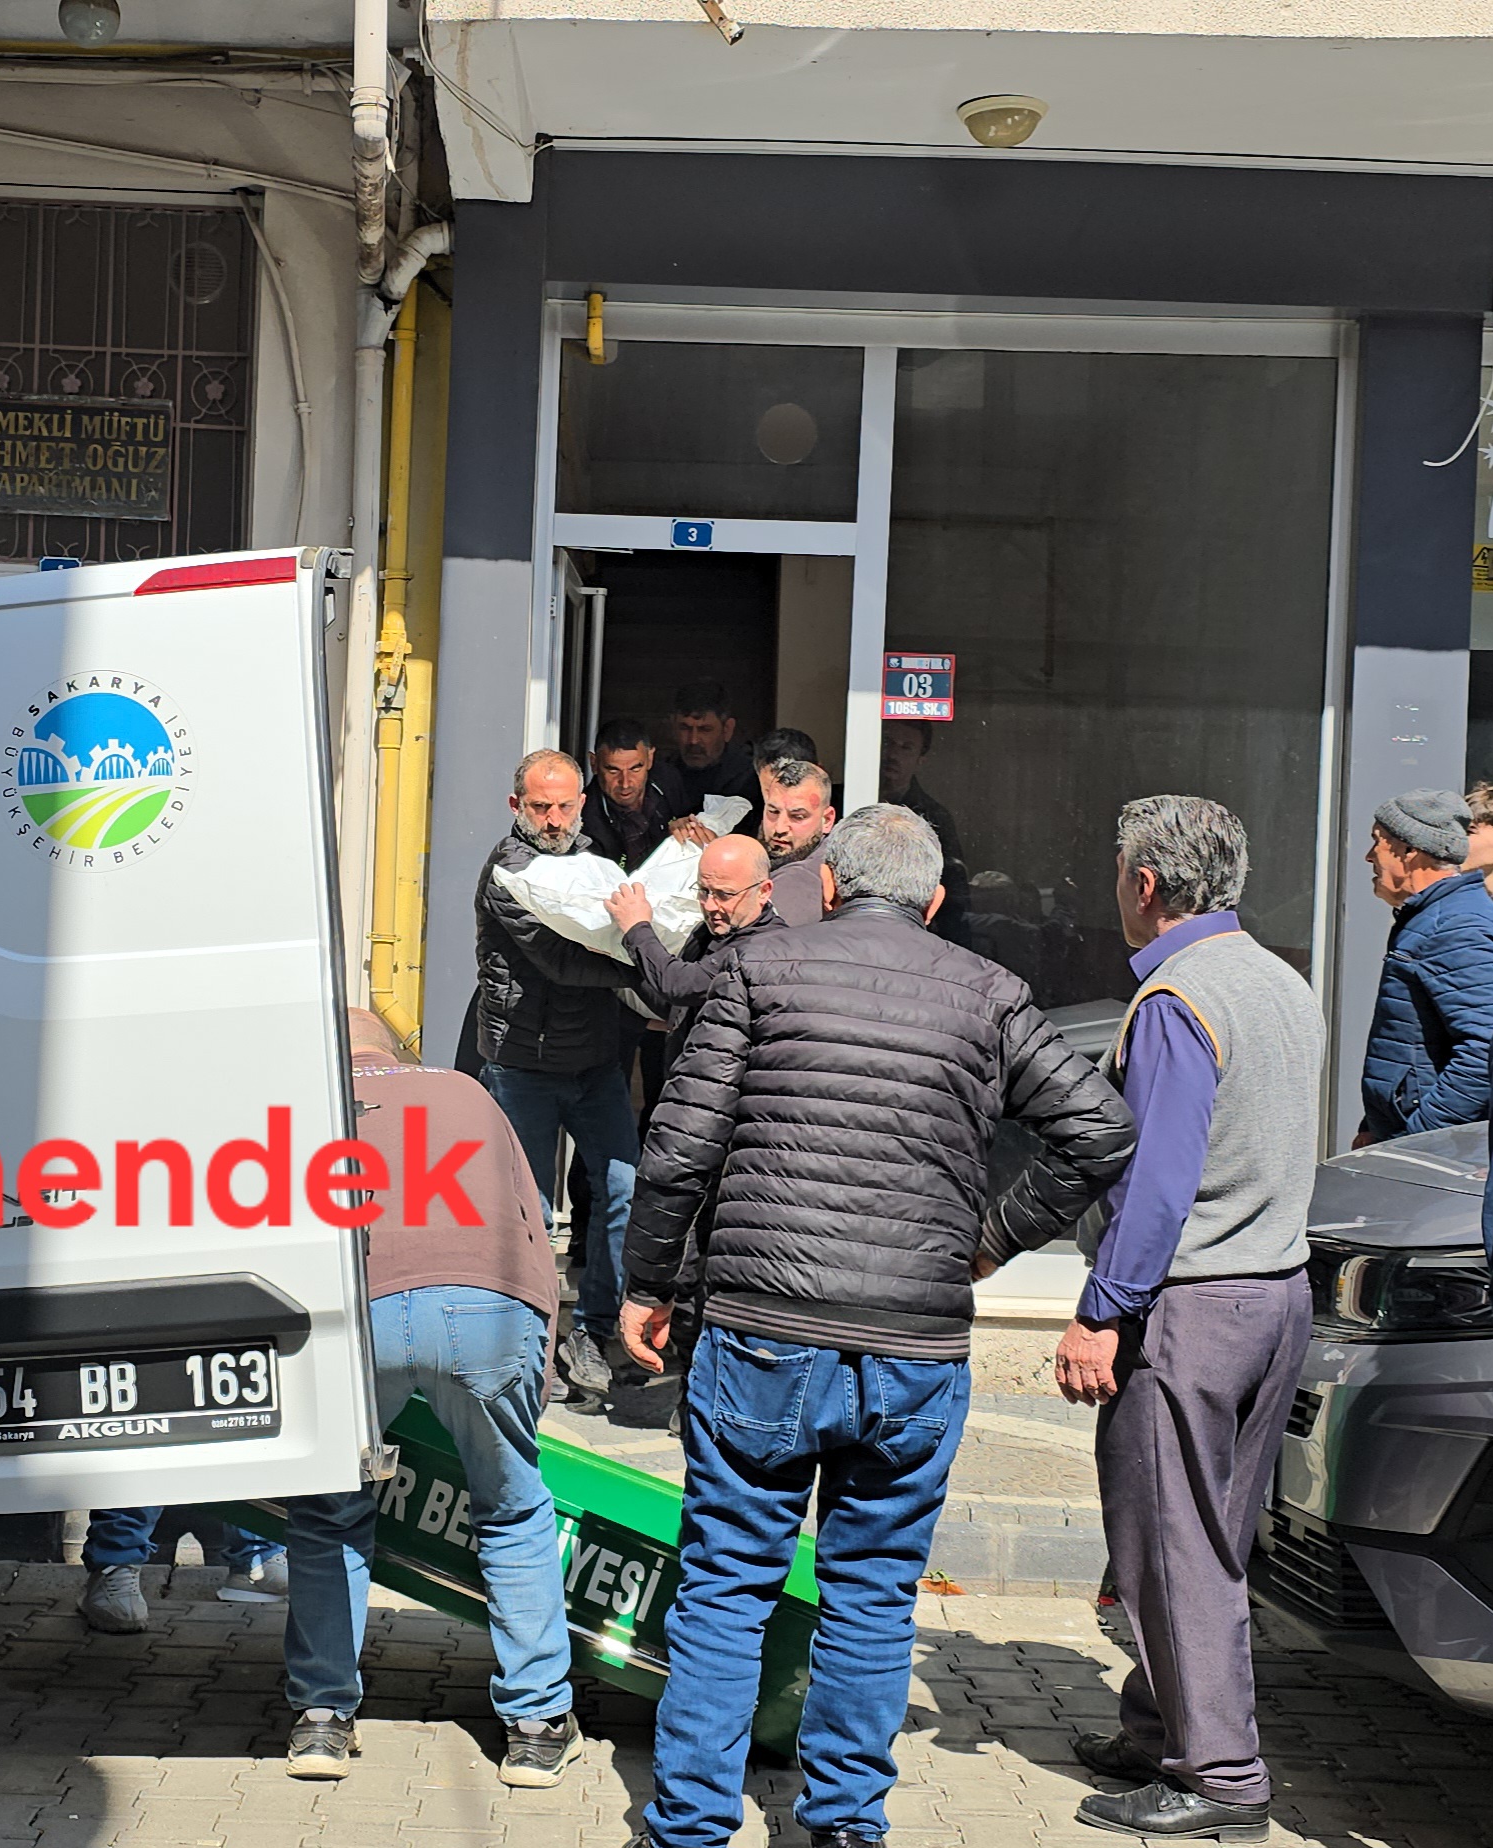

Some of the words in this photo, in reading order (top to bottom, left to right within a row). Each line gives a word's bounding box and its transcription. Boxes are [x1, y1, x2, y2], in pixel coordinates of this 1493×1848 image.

[81, 412, 165, 441] MÜFTÜ
[85, 442, 167, 473] OĞUZ
[688, 527, 697, 542] 3
[28, 676, 162, 717] SAKARYA
[903, 673, 933, 698] 03
[1, 727, 94, 867] BÜYÜKŞEHİR
[79, 1361, 138, 1414] BB
[185, 1350, 268, 1407] 163
[228, 1416, 245, 1427] 276
[245, 1415, 258, 1426] 72
[417, 1478, 665, 1623] BEİYESİ
